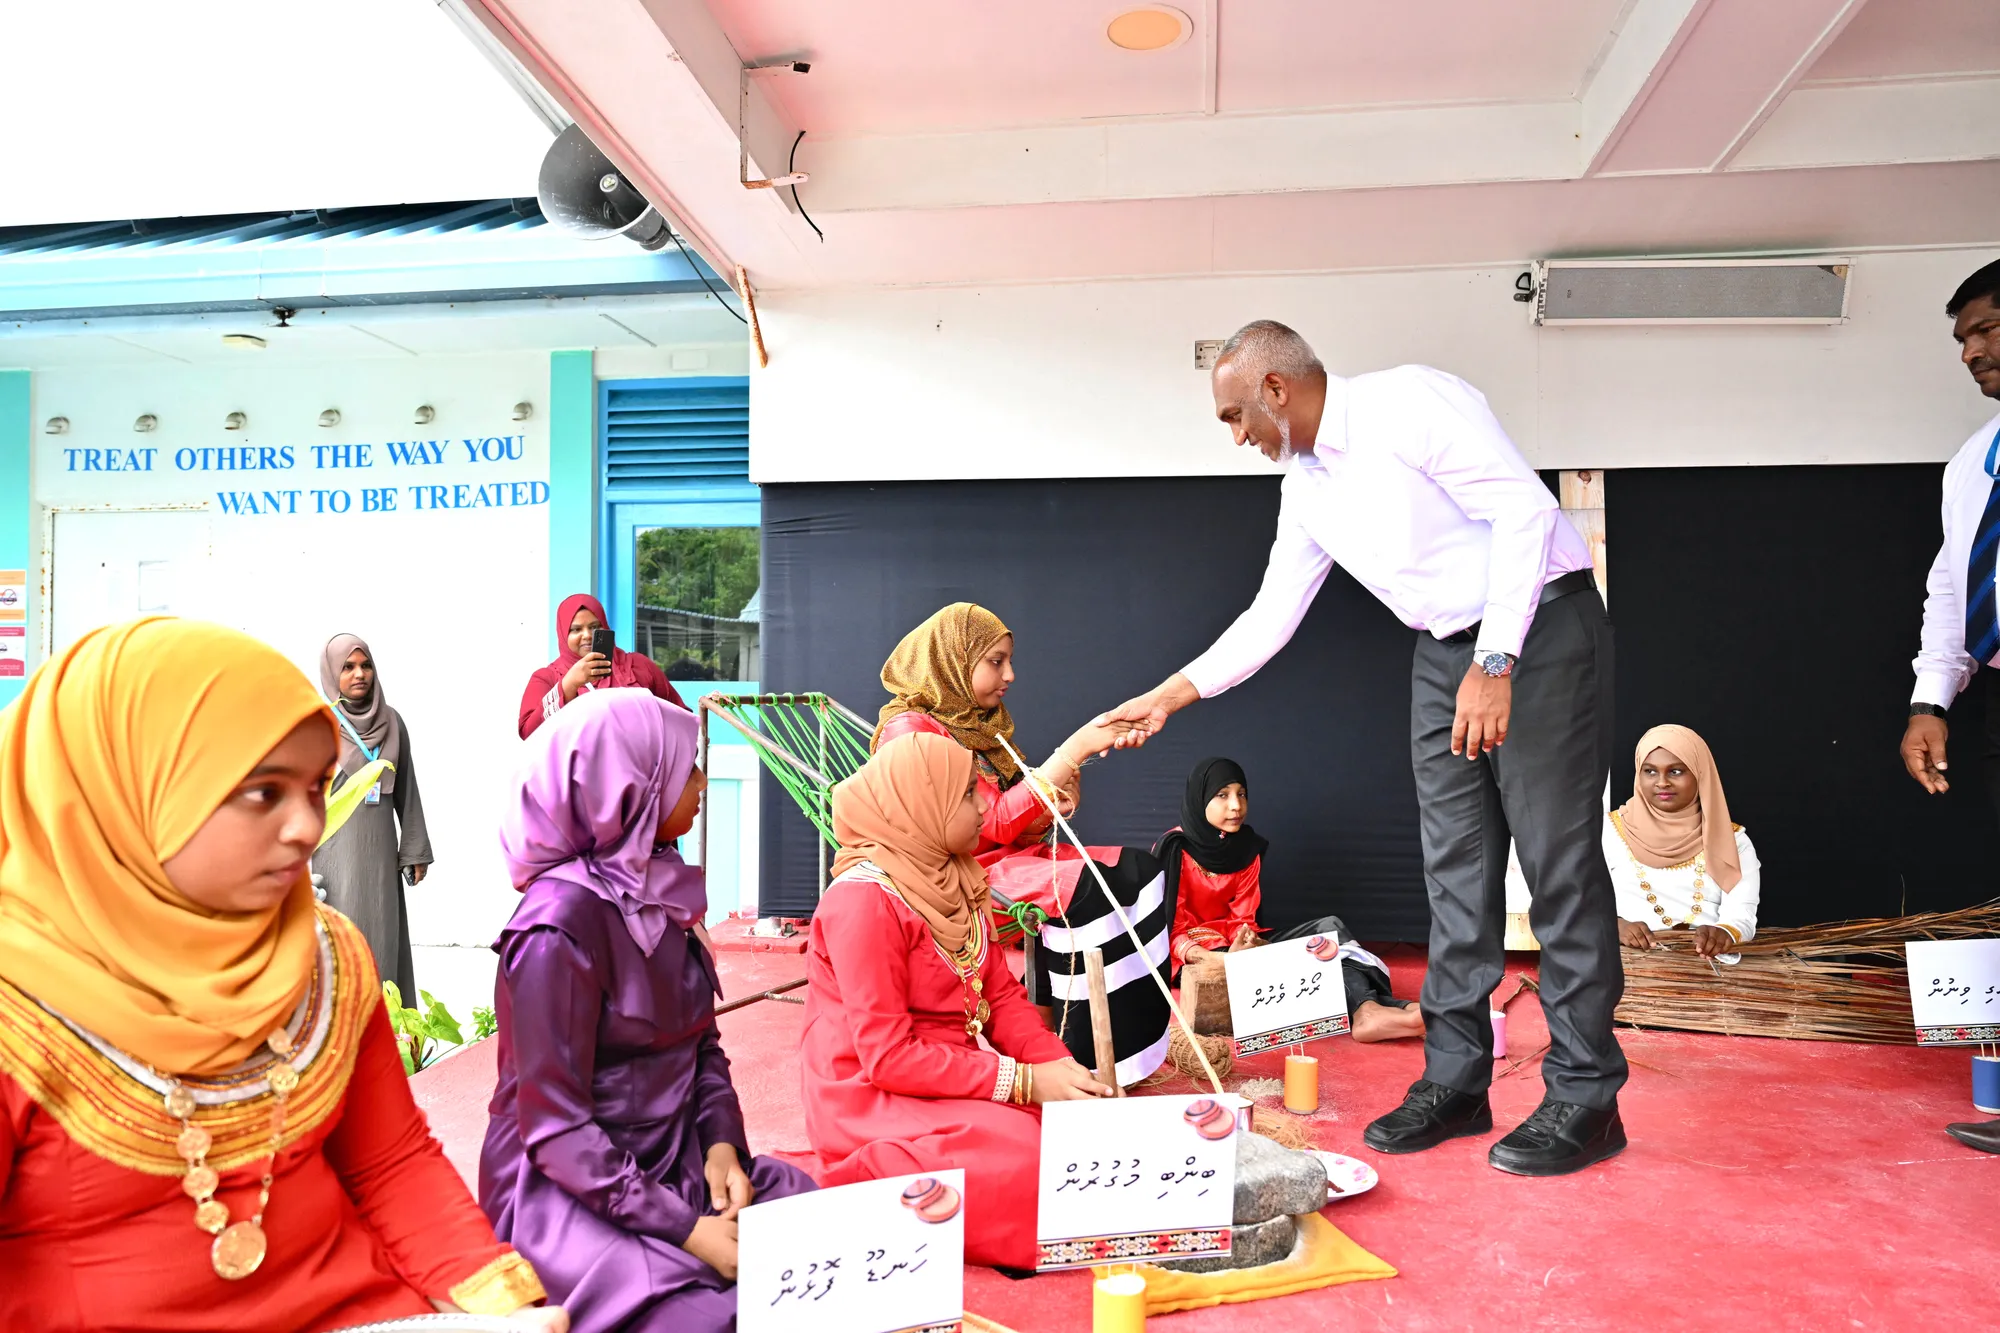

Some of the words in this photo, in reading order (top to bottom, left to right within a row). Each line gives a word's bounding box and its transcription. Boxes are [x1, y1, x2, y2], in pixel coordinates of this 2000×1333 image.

[63, 447, 158, 472] TREAT
[174, 445, 296, 472] OTHERS
[309, 443, 373, 470] THE
[385, 440, 450, 466] WAY
[462, 435, 524, 463] YOU
[216, 489, 303, 515] WANT
[310, 489, 352, 514] TO
[360, 487, 399, 513] BE
[408, 480, 550, 510] TREATED
[1056, 1158, 1141, 1192] މުގުރުން
[1157, 1156, 1216, 1200] ބިންބި
